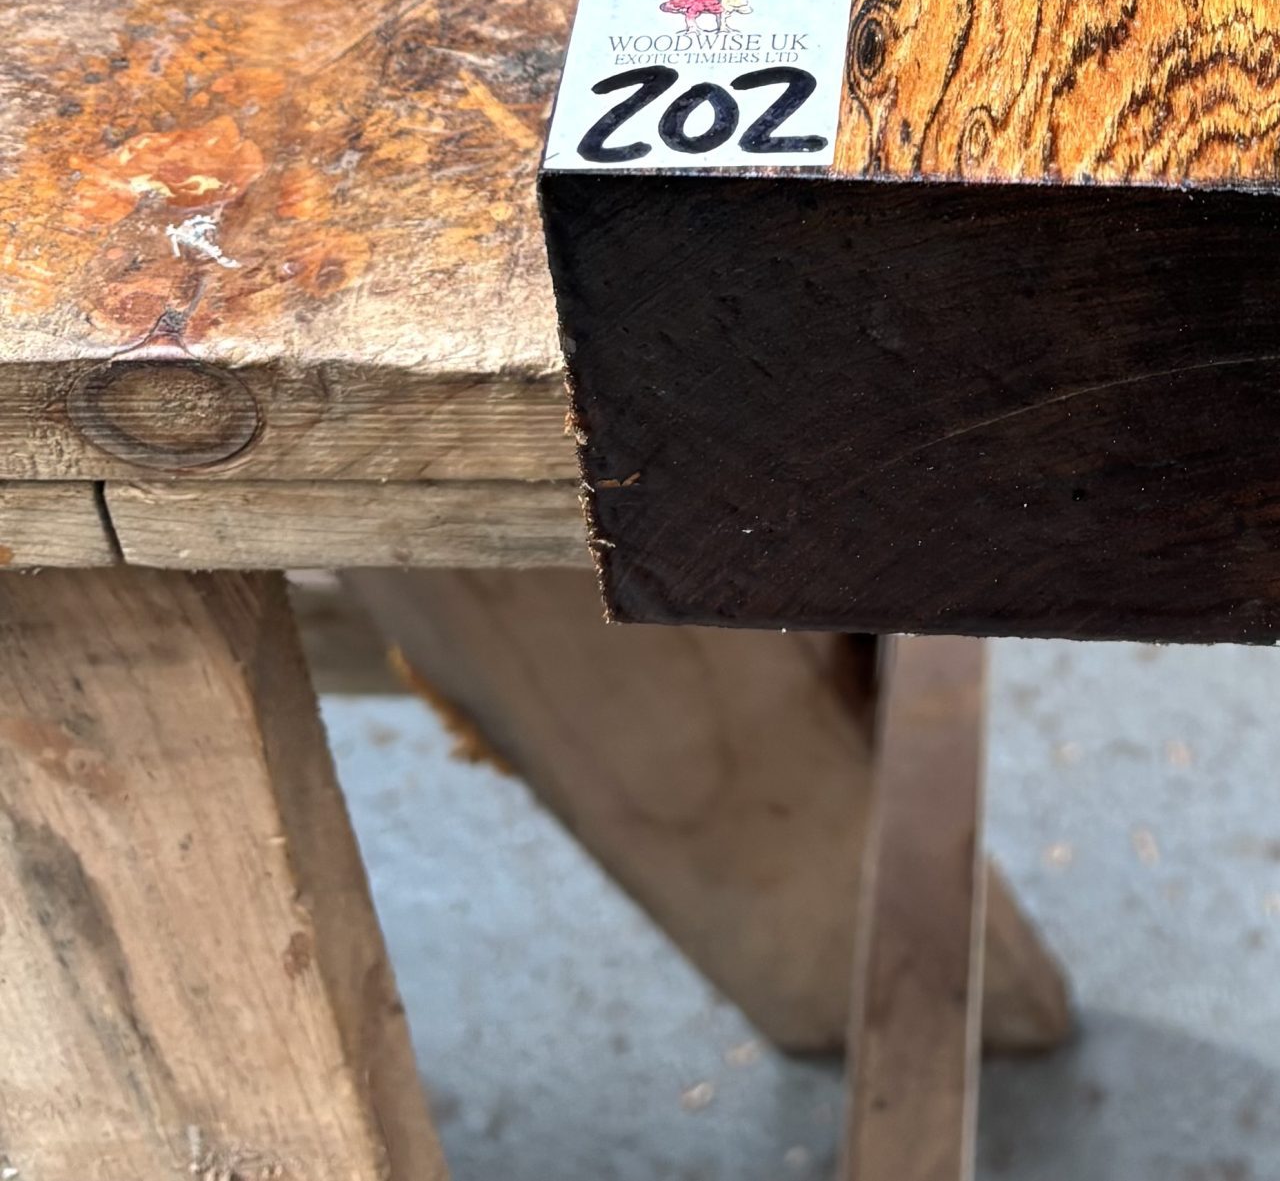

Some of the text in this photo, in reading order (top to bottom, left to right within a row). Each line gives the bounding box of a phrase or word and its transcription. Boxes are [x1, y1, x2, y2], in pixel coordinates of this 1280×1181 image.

[609, 34, 808, 52] WOODWISE UK
[614, 52, 799, 65] EXOTIC TIMBERS LTD
[577, 65, 828, 163] 202
